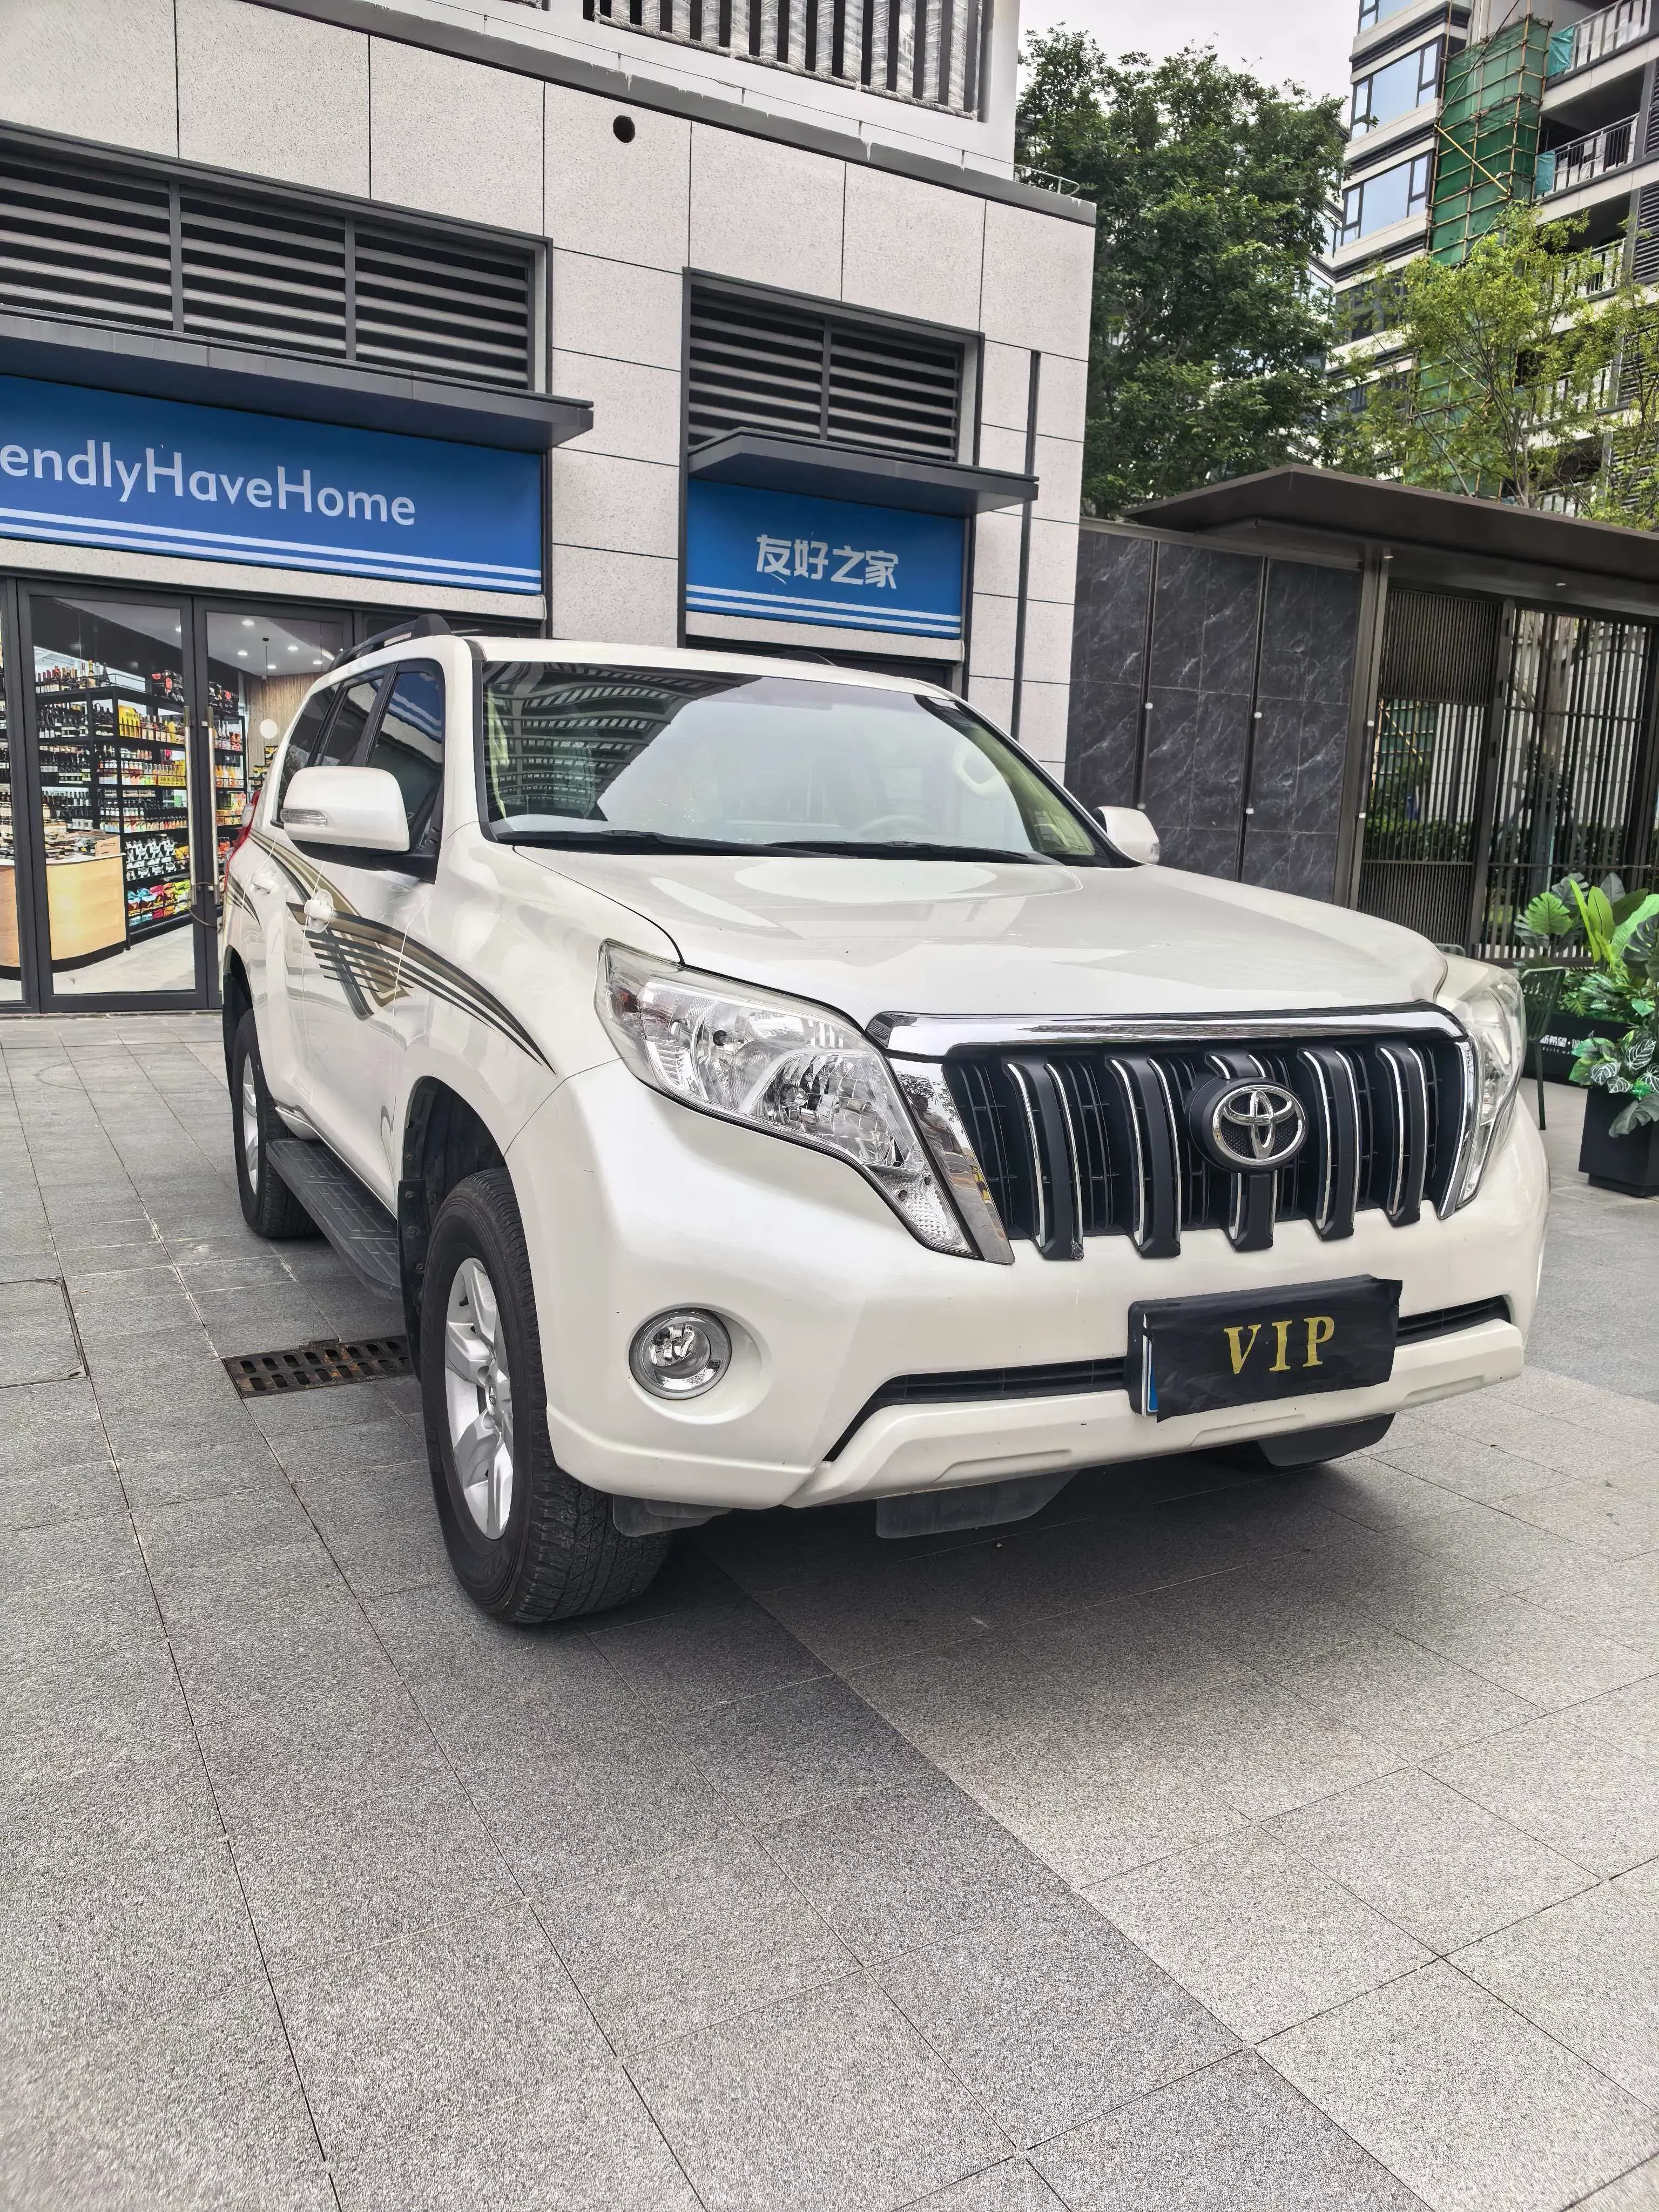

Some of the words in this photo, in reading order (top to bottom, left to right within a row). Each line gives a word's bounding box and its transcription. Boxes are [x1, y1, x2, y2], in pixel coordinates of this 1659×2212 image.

[0, 440, 415, 525] endlyHaveHome
[757, 534, 899, 589] 友好之家
[1224, 1316, 1335, 1374] VIP
